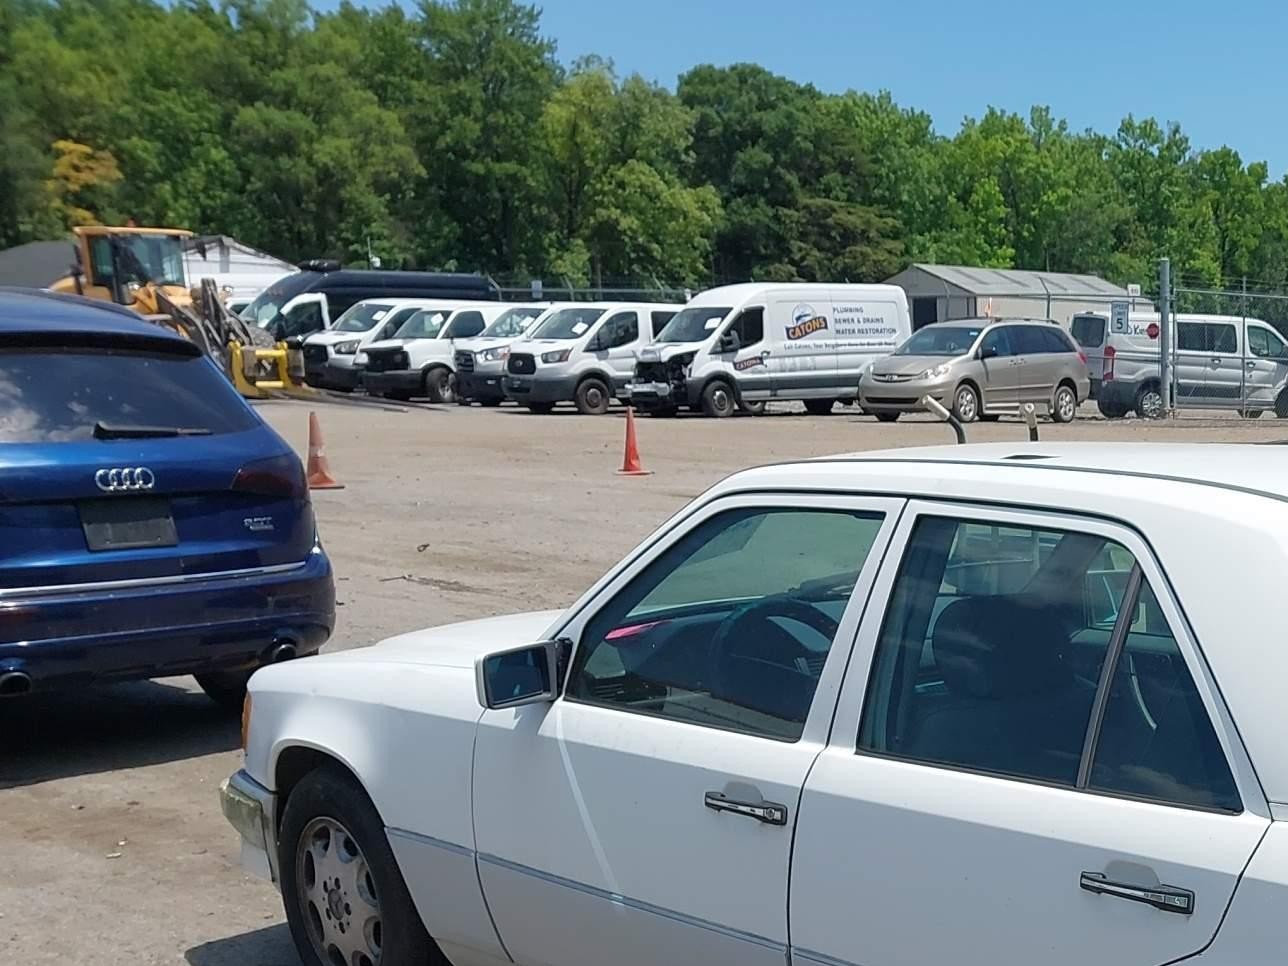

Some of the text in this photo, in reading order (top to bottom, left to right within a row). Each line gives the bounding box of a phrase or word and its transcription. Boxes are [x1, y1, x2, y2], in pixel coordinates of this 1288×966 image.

[788, 317, 826, 339] CATONS
[1116, 318, 1123, 330] 5
[859, 327, 897, 335] RESTORATION
